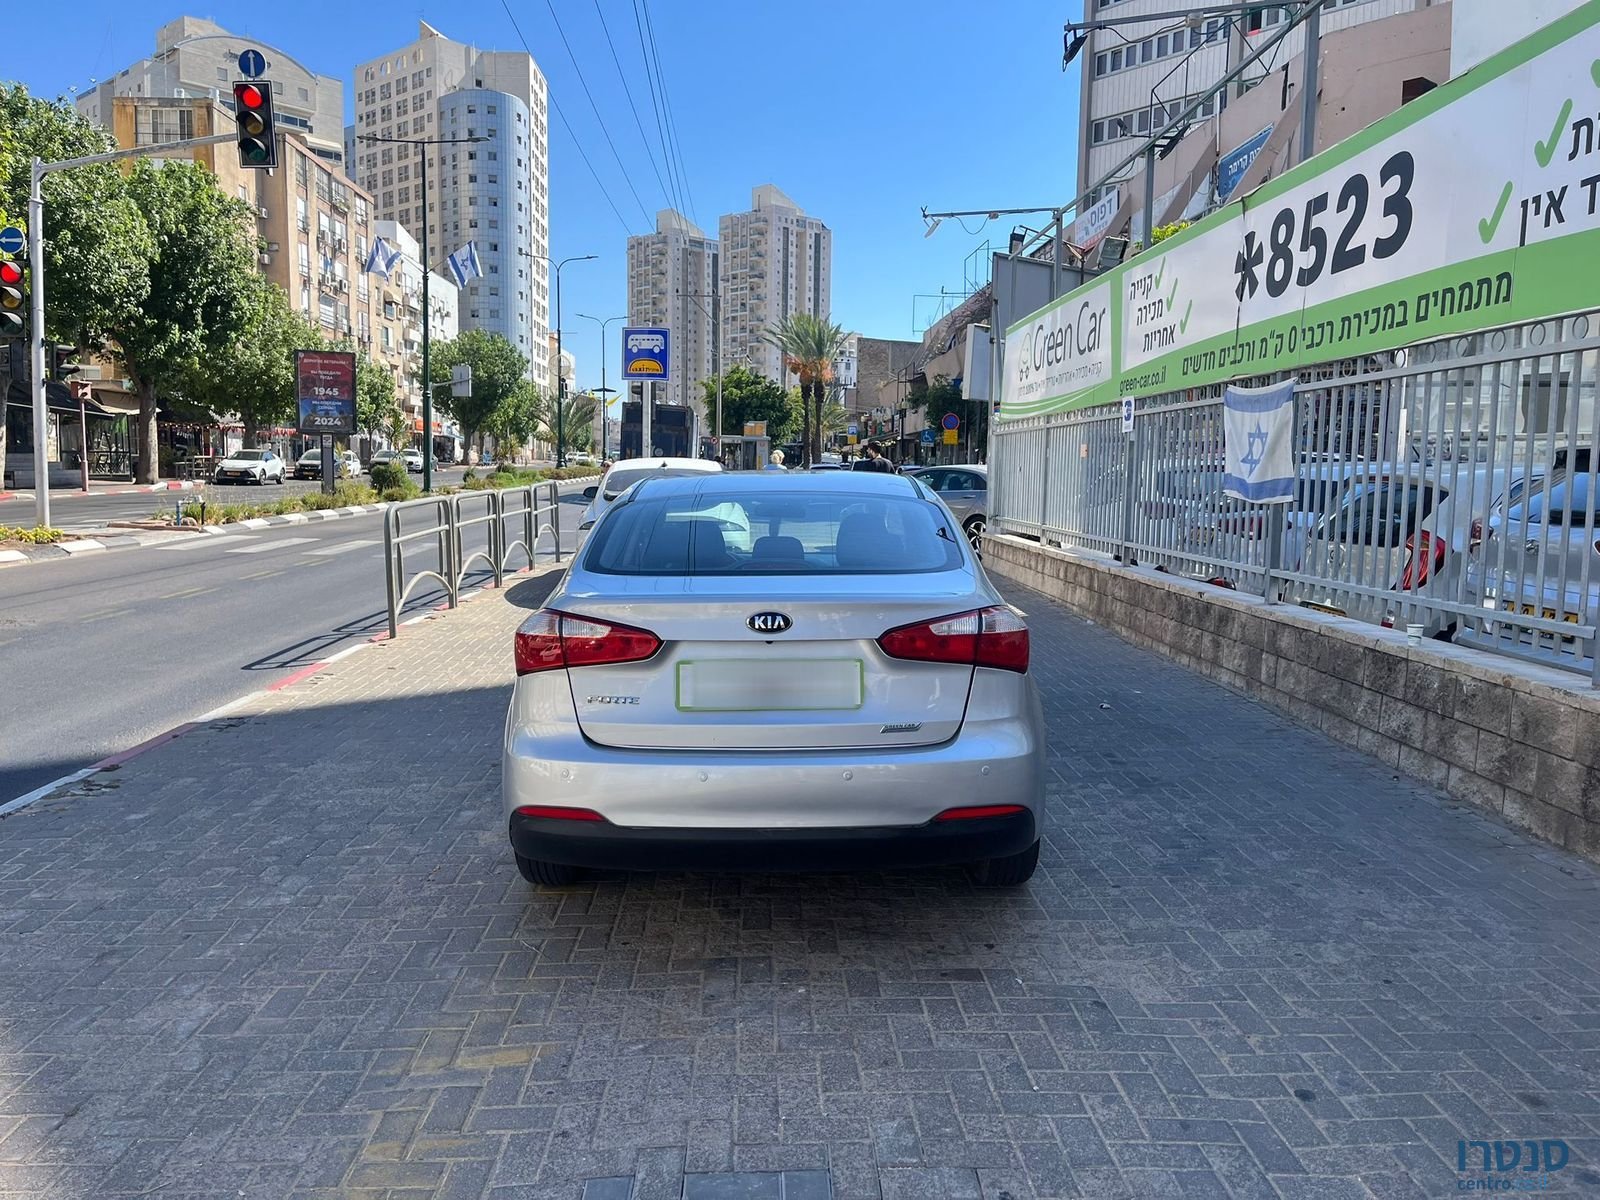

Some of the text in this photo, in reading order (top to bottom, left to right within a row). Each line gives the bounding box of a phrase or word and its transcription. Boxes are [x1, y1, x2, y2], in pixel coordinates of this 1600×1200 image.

[1568, 113, 1600, 161] ת
[1090, 198, 1113, 227] דפוס
[1519, 185, 1568, 247] אין
[1130, 274, 1153, 300] קנייה
[1415, 271, 1512, 323] מתמחים
[1137, 298, 1164, 326] מכירה
[1338, 300, 1408, 342] במכירת
[1033, 301, 1106, 372] Green Car
[1143, 323, 1176, 352] אחריות
[1288, 325, 1297, 354] 0
[1302, 320, 1334, 350] רכבי
[1182, 350, 1216, 376] חדשים
[1218, 339, 1256, 369] ורכבים
[314, 387, 339, 396] 1945
[1119, 365, 1167, 397] green-car.co.il
[314, 417, 342, 426] 2024
[754, 615, 786, 629] KIA
[586, 695, 640, 705] FORTE
